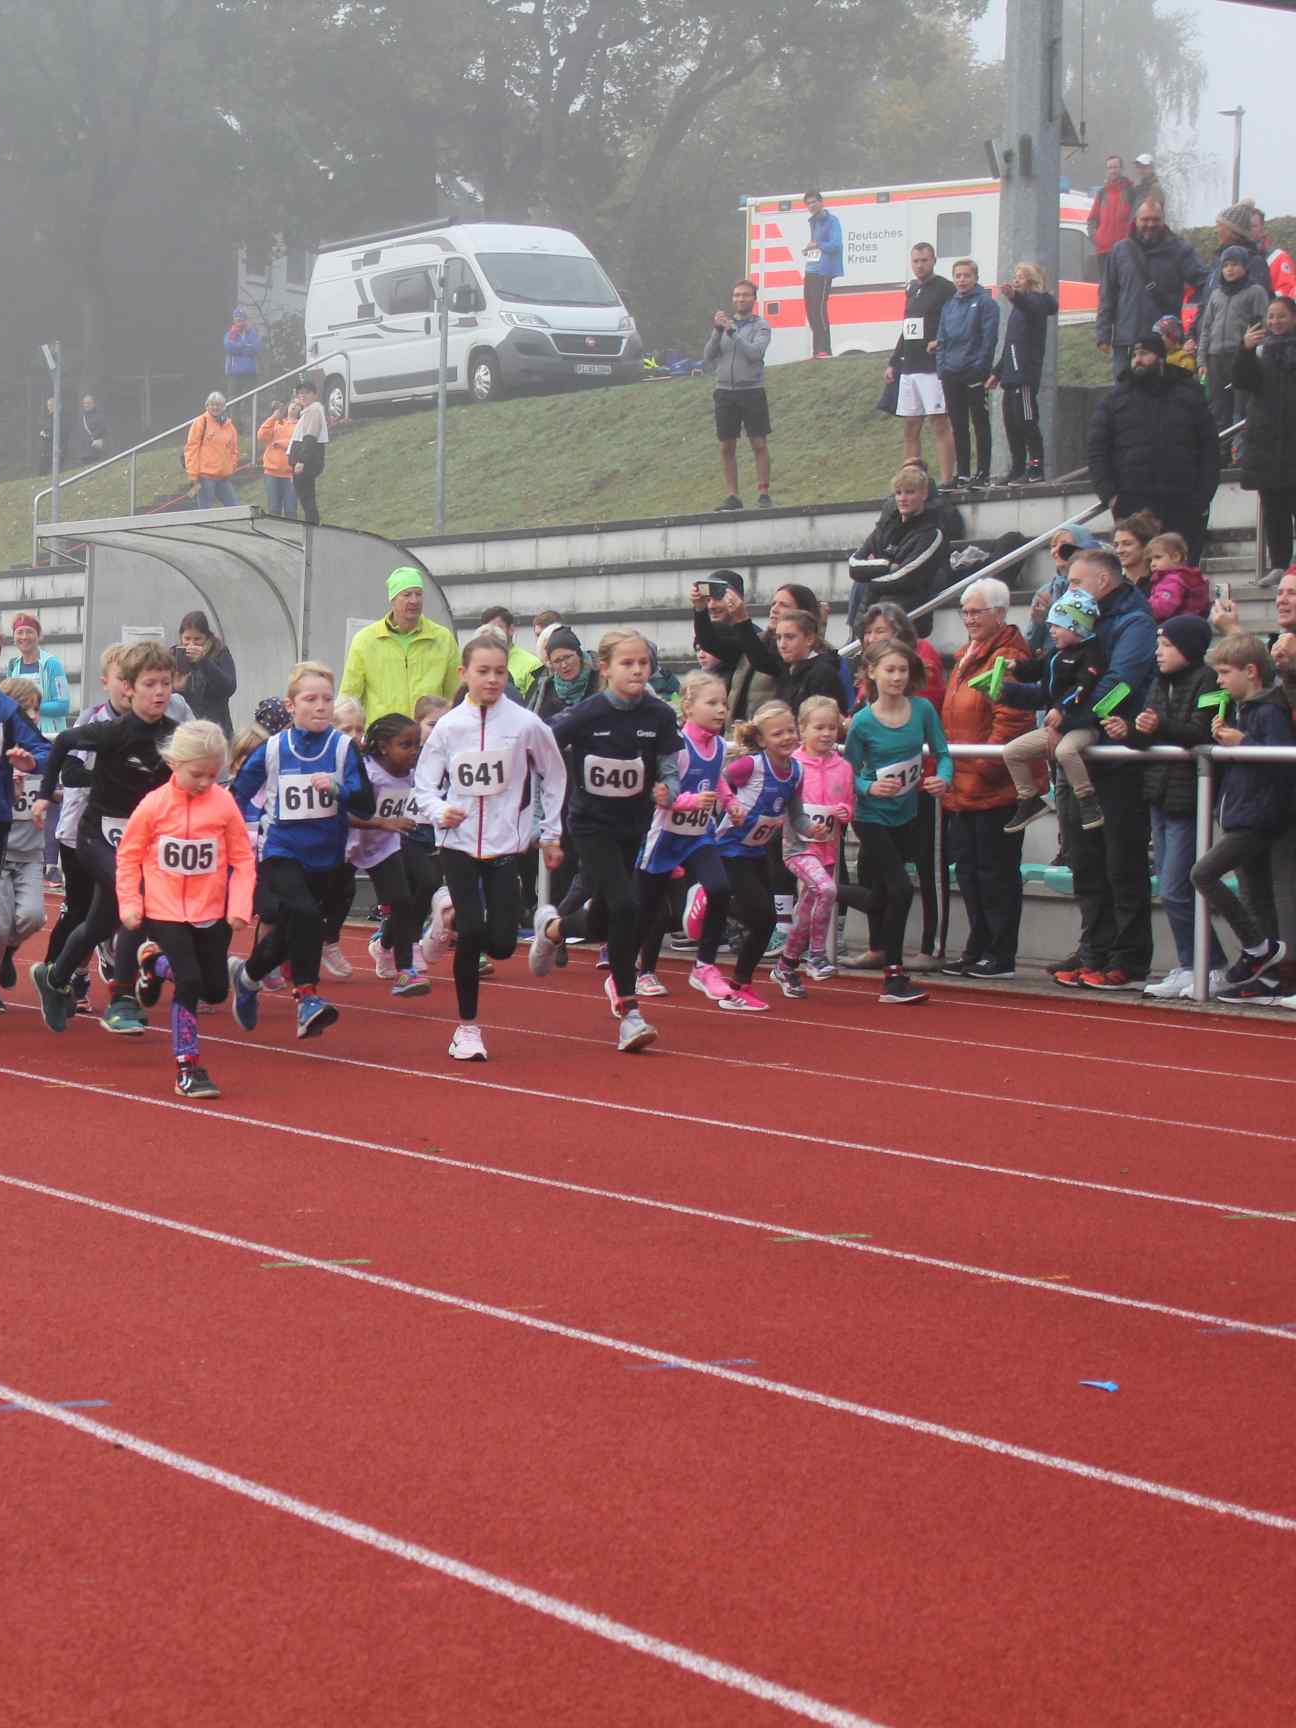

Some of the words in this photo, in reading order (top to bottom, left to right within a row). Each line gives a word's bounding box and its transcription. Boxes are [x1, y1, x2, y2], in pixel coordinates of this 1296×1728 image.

[848, 230, 903, 241] Deutsches
[848, 243, 878, 253] Rotes
[848, 254, 877, 264] Kreuz
[457, 760, 504, 787] 641
[590, 766, 638, 789] 640
[885, 764, 919, 787] 12
[164, 842, 213, 870] 605
